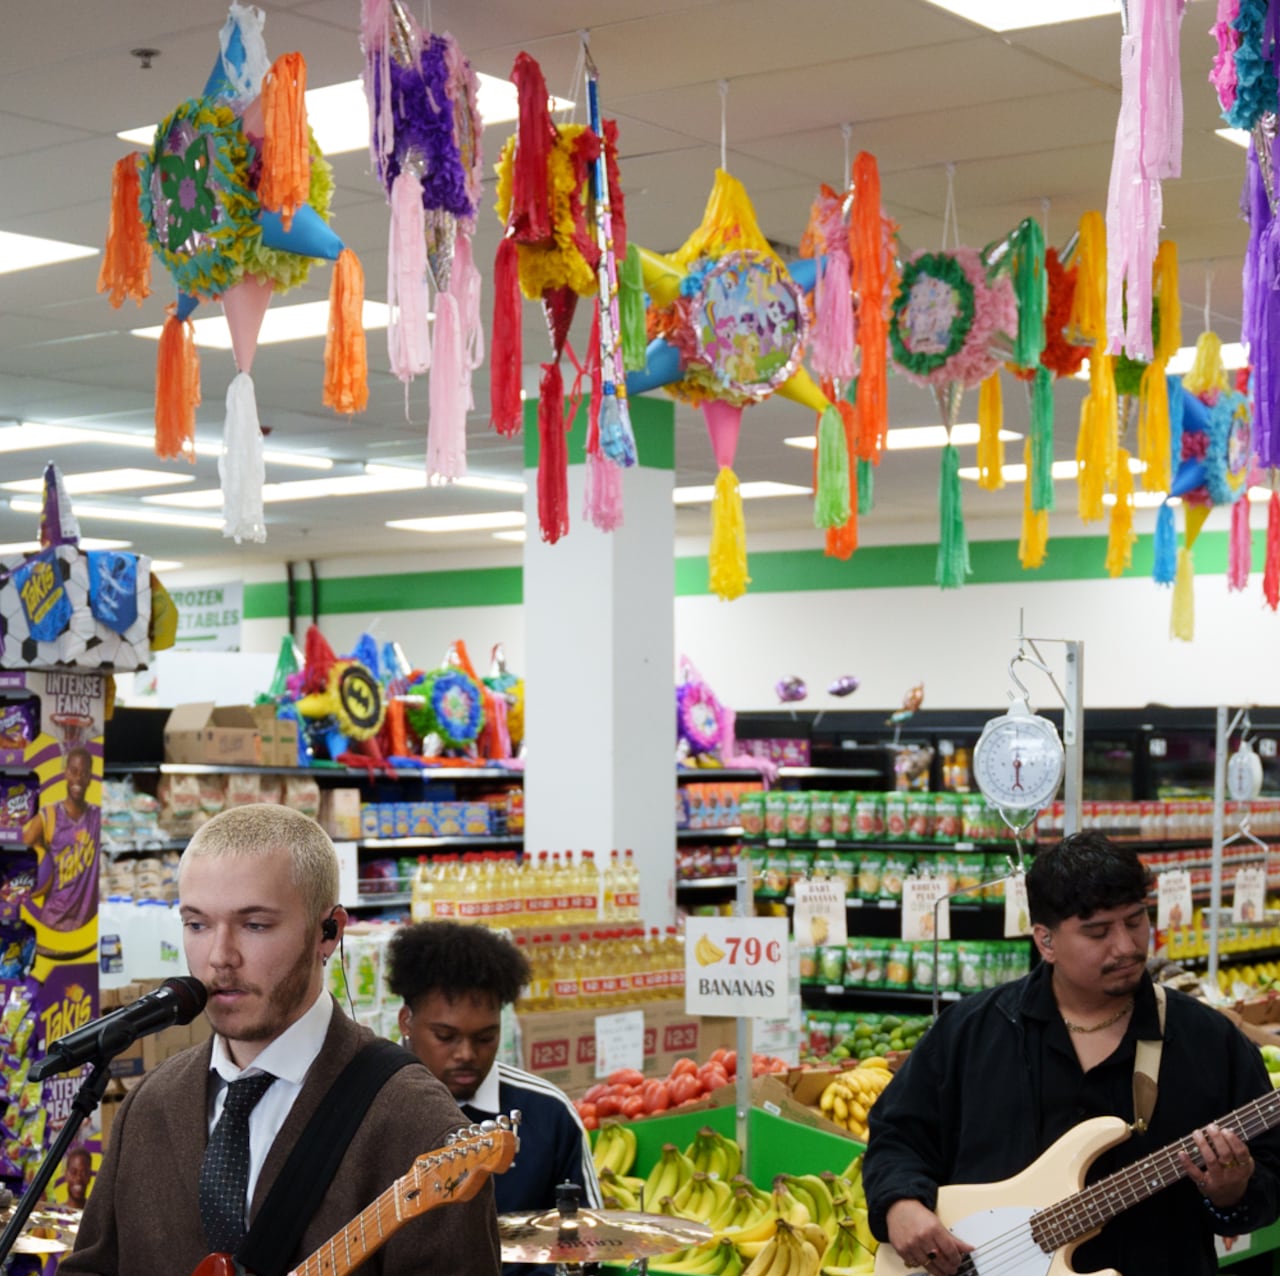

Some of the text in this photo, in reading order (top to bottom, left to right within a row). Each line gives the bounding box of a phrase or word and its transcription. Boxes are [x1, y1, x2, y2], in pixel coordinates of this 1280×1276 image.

[21, 562, 54, 619] Takis
[176, 611, 240, 631] ETABLES
[46, 674, 100, 697] INTENSE
[56, 695, 91, 717] FANS
[54, 832, 95, 890] Takis
[725, 937, 781, 966] 79¢
[699, 978, 775, 998] BANANAS
[40, 994, 93, 1052] Takis
